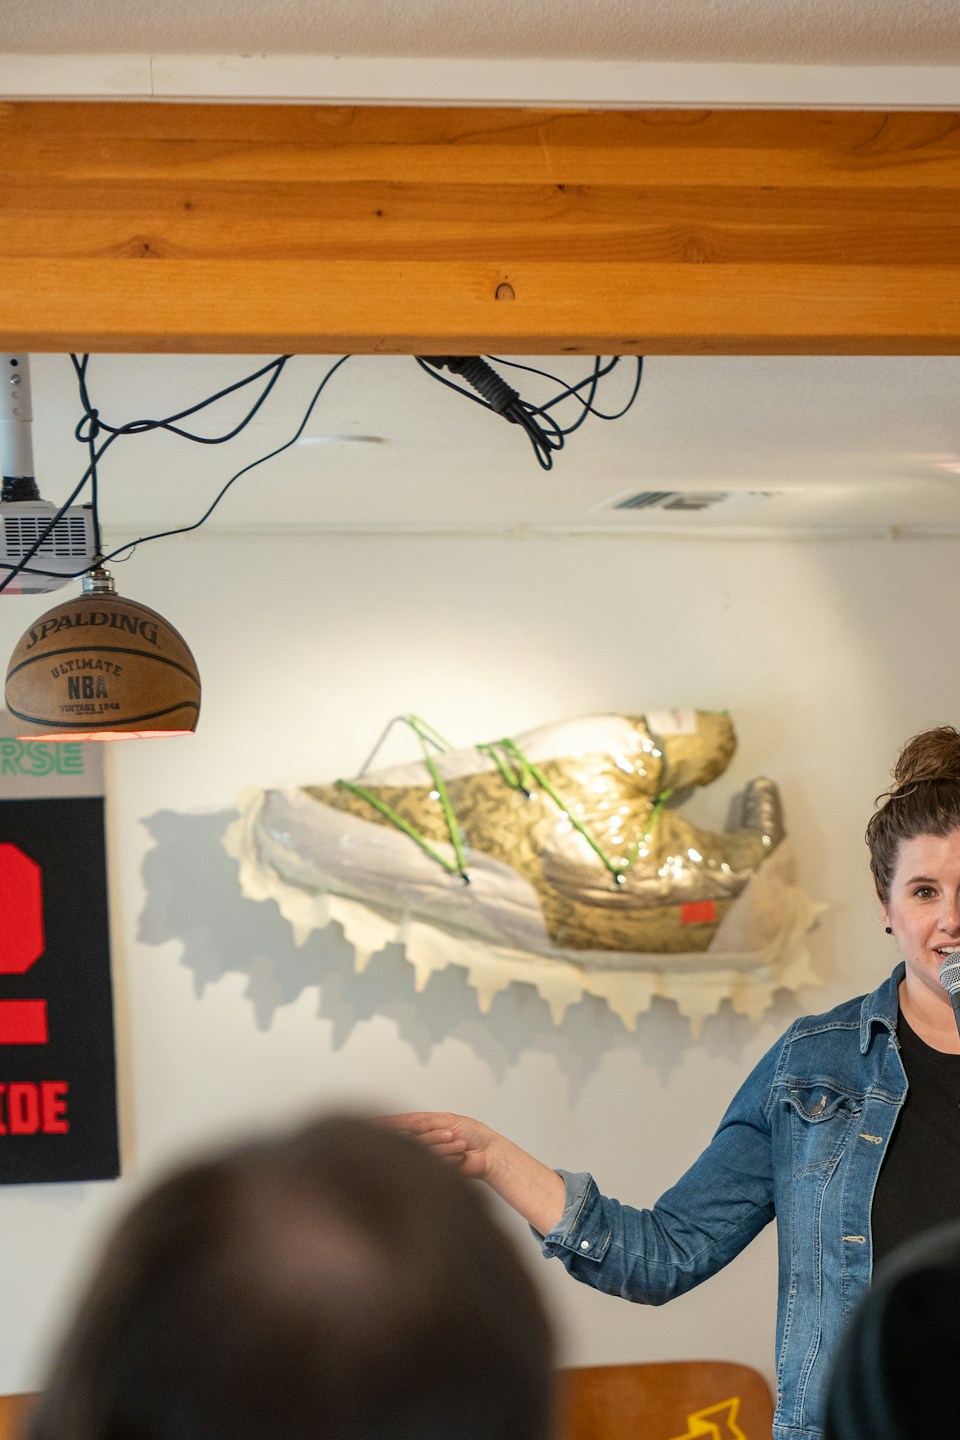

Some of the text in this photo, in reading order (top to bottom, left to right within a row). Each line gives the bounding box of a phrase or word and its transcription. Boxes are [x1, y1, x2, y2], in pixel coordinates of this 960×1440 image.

[26, 611, 158, 650] SPALDING
[51, 658, 123, 679] ULTIMATE
[68, 675, 108, 700] NBA
